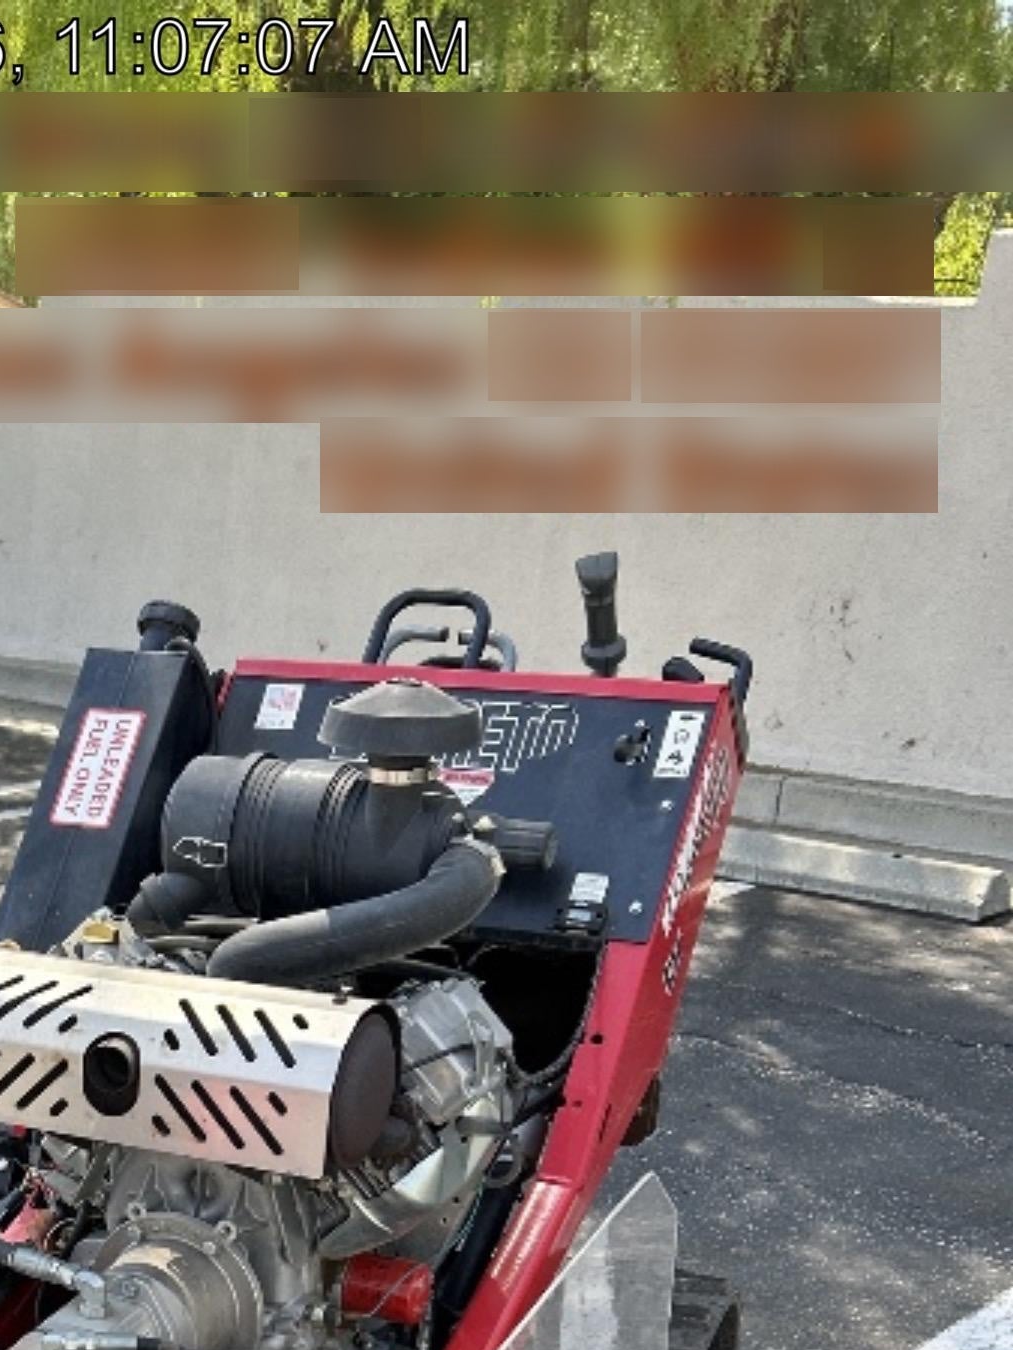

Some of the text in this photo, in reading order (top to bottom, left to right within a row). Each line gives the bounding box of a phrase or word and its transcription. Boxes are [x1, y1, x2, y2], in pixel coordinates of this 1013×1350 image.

[64, 717, 109, 817] FUEL ONLY
[86, 718, 133, 817] UNLEADED
